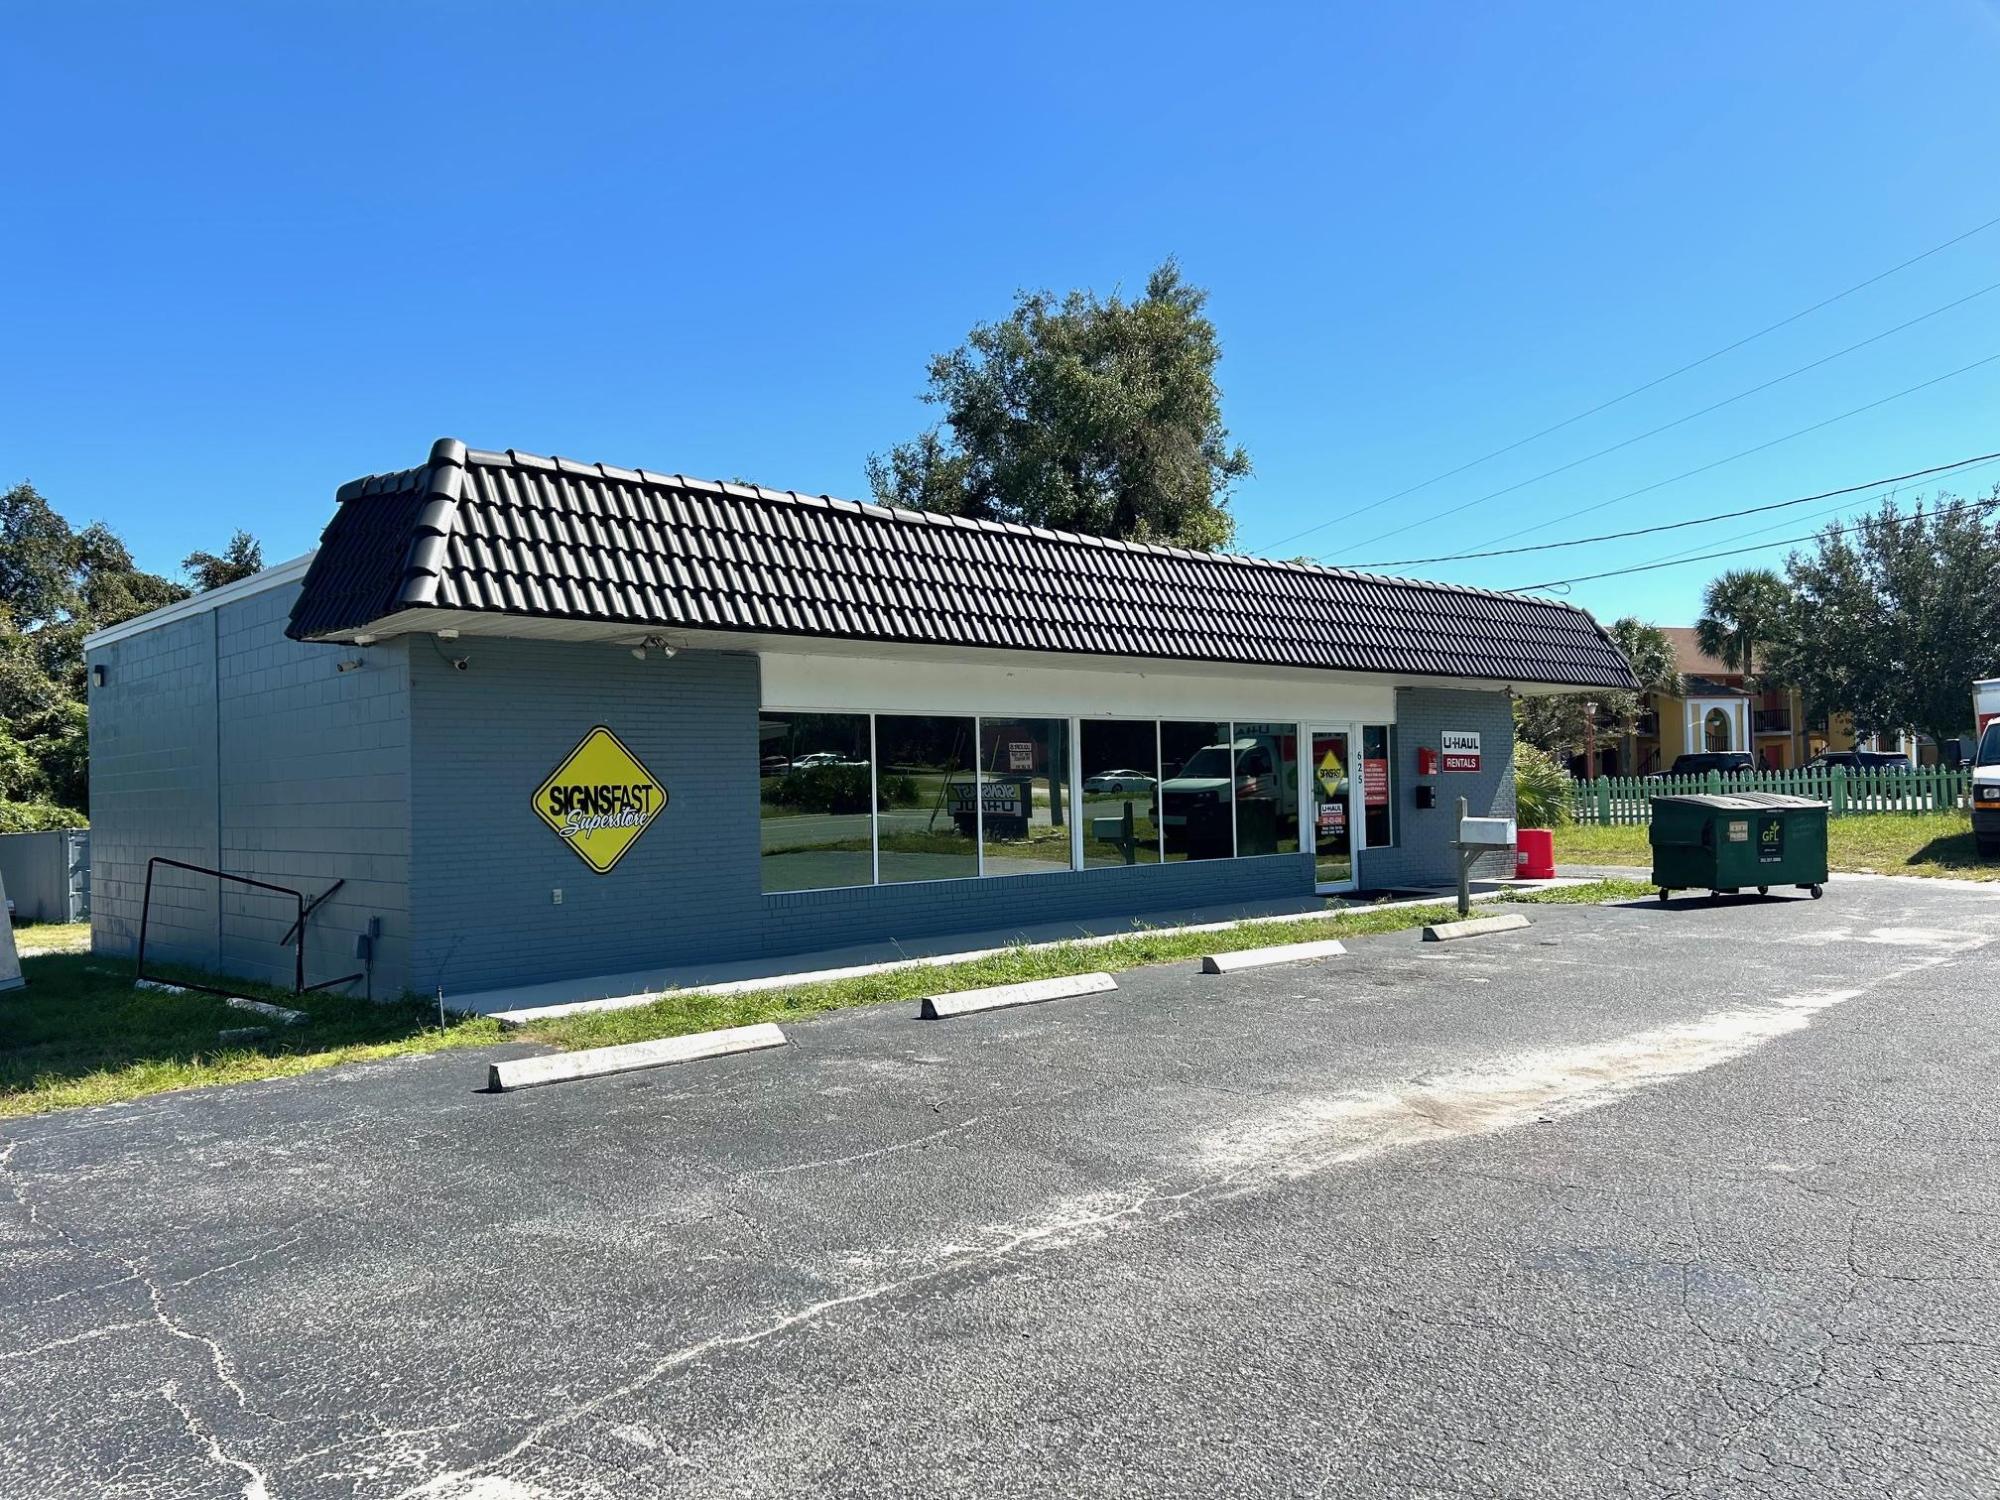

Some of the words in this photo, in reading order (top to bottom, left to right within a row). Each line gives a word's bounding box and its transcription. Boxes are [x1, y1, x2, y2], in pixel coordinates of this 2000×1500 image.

[1443, 736, 1479, 750] U-HAUL
[1446, 758, 1476, 768] RENTALS
[550, 784, 653, 816] SIGNSFAST
[558, 806, 649, 839] Superstore
[1762, 828, 1779, 842] GFL
